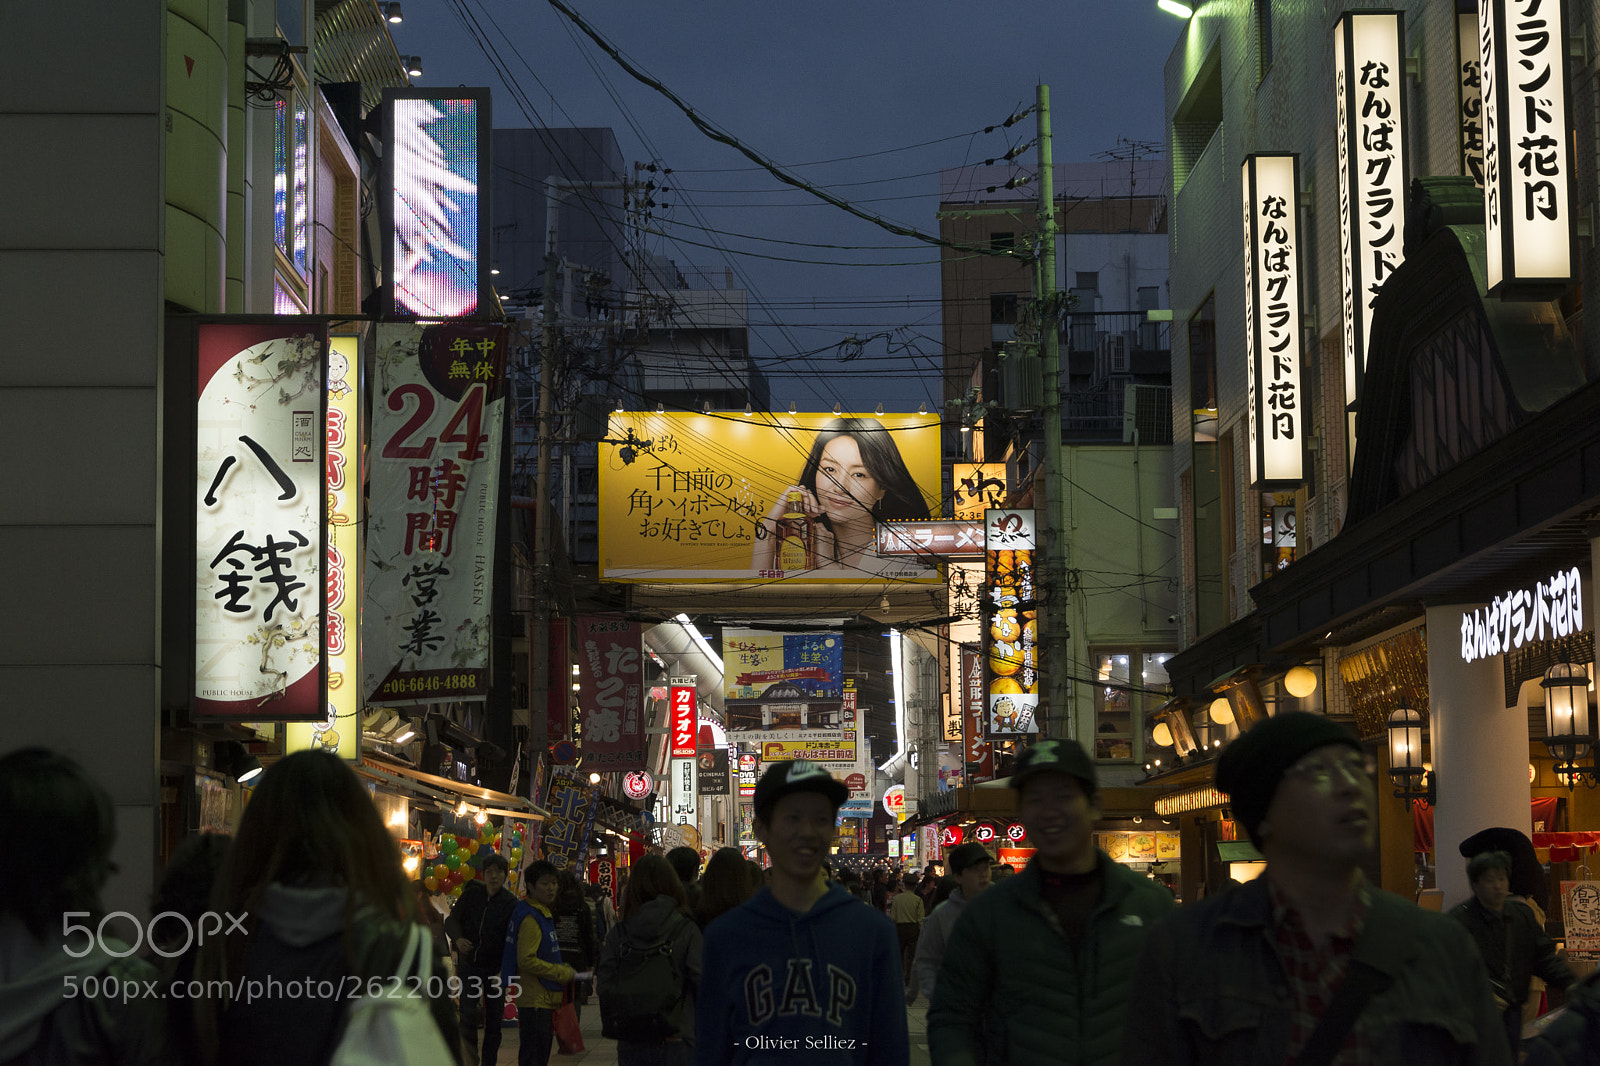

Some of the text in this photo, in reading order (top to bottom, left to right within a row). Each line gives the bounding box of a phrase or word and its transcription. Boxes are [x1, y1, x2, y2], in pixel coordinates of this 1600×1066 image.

[1360, 60, 1398, 311] なんばグランド
[1262, 194, 1295, 440] なんばグランド花月
[449, 337, 496, 358] 年中
[448, 360, 495, 380] 無休
[295, 418, 312, 427] 酒
[382, 384, 488, 461] 24
[295, 446, 312, 457] 処
[645, 464, 733, 493] 千日前の
[627, 488, 765, 518] 角ハイボールが
[204, 435, 309, 622] 八銭
[639, 517, 751, 543] お好きでしょ。
[472, 483, 488, 606] PUBLIC HOUSE HASSEN
[759, 570, 785, 578] 千日前
[1461, 567, 1583, 663] なんばグランド花月
[585, 643, 639, 743] たこ焼
[676, 690, 692, 745] カラオケ
[793, 749, 854, 759] なんば千日前店
[976, 827, 993, 839] わ
[1008, 826, 1024, 839] な
[744, 958, 857, 1027] GAP
